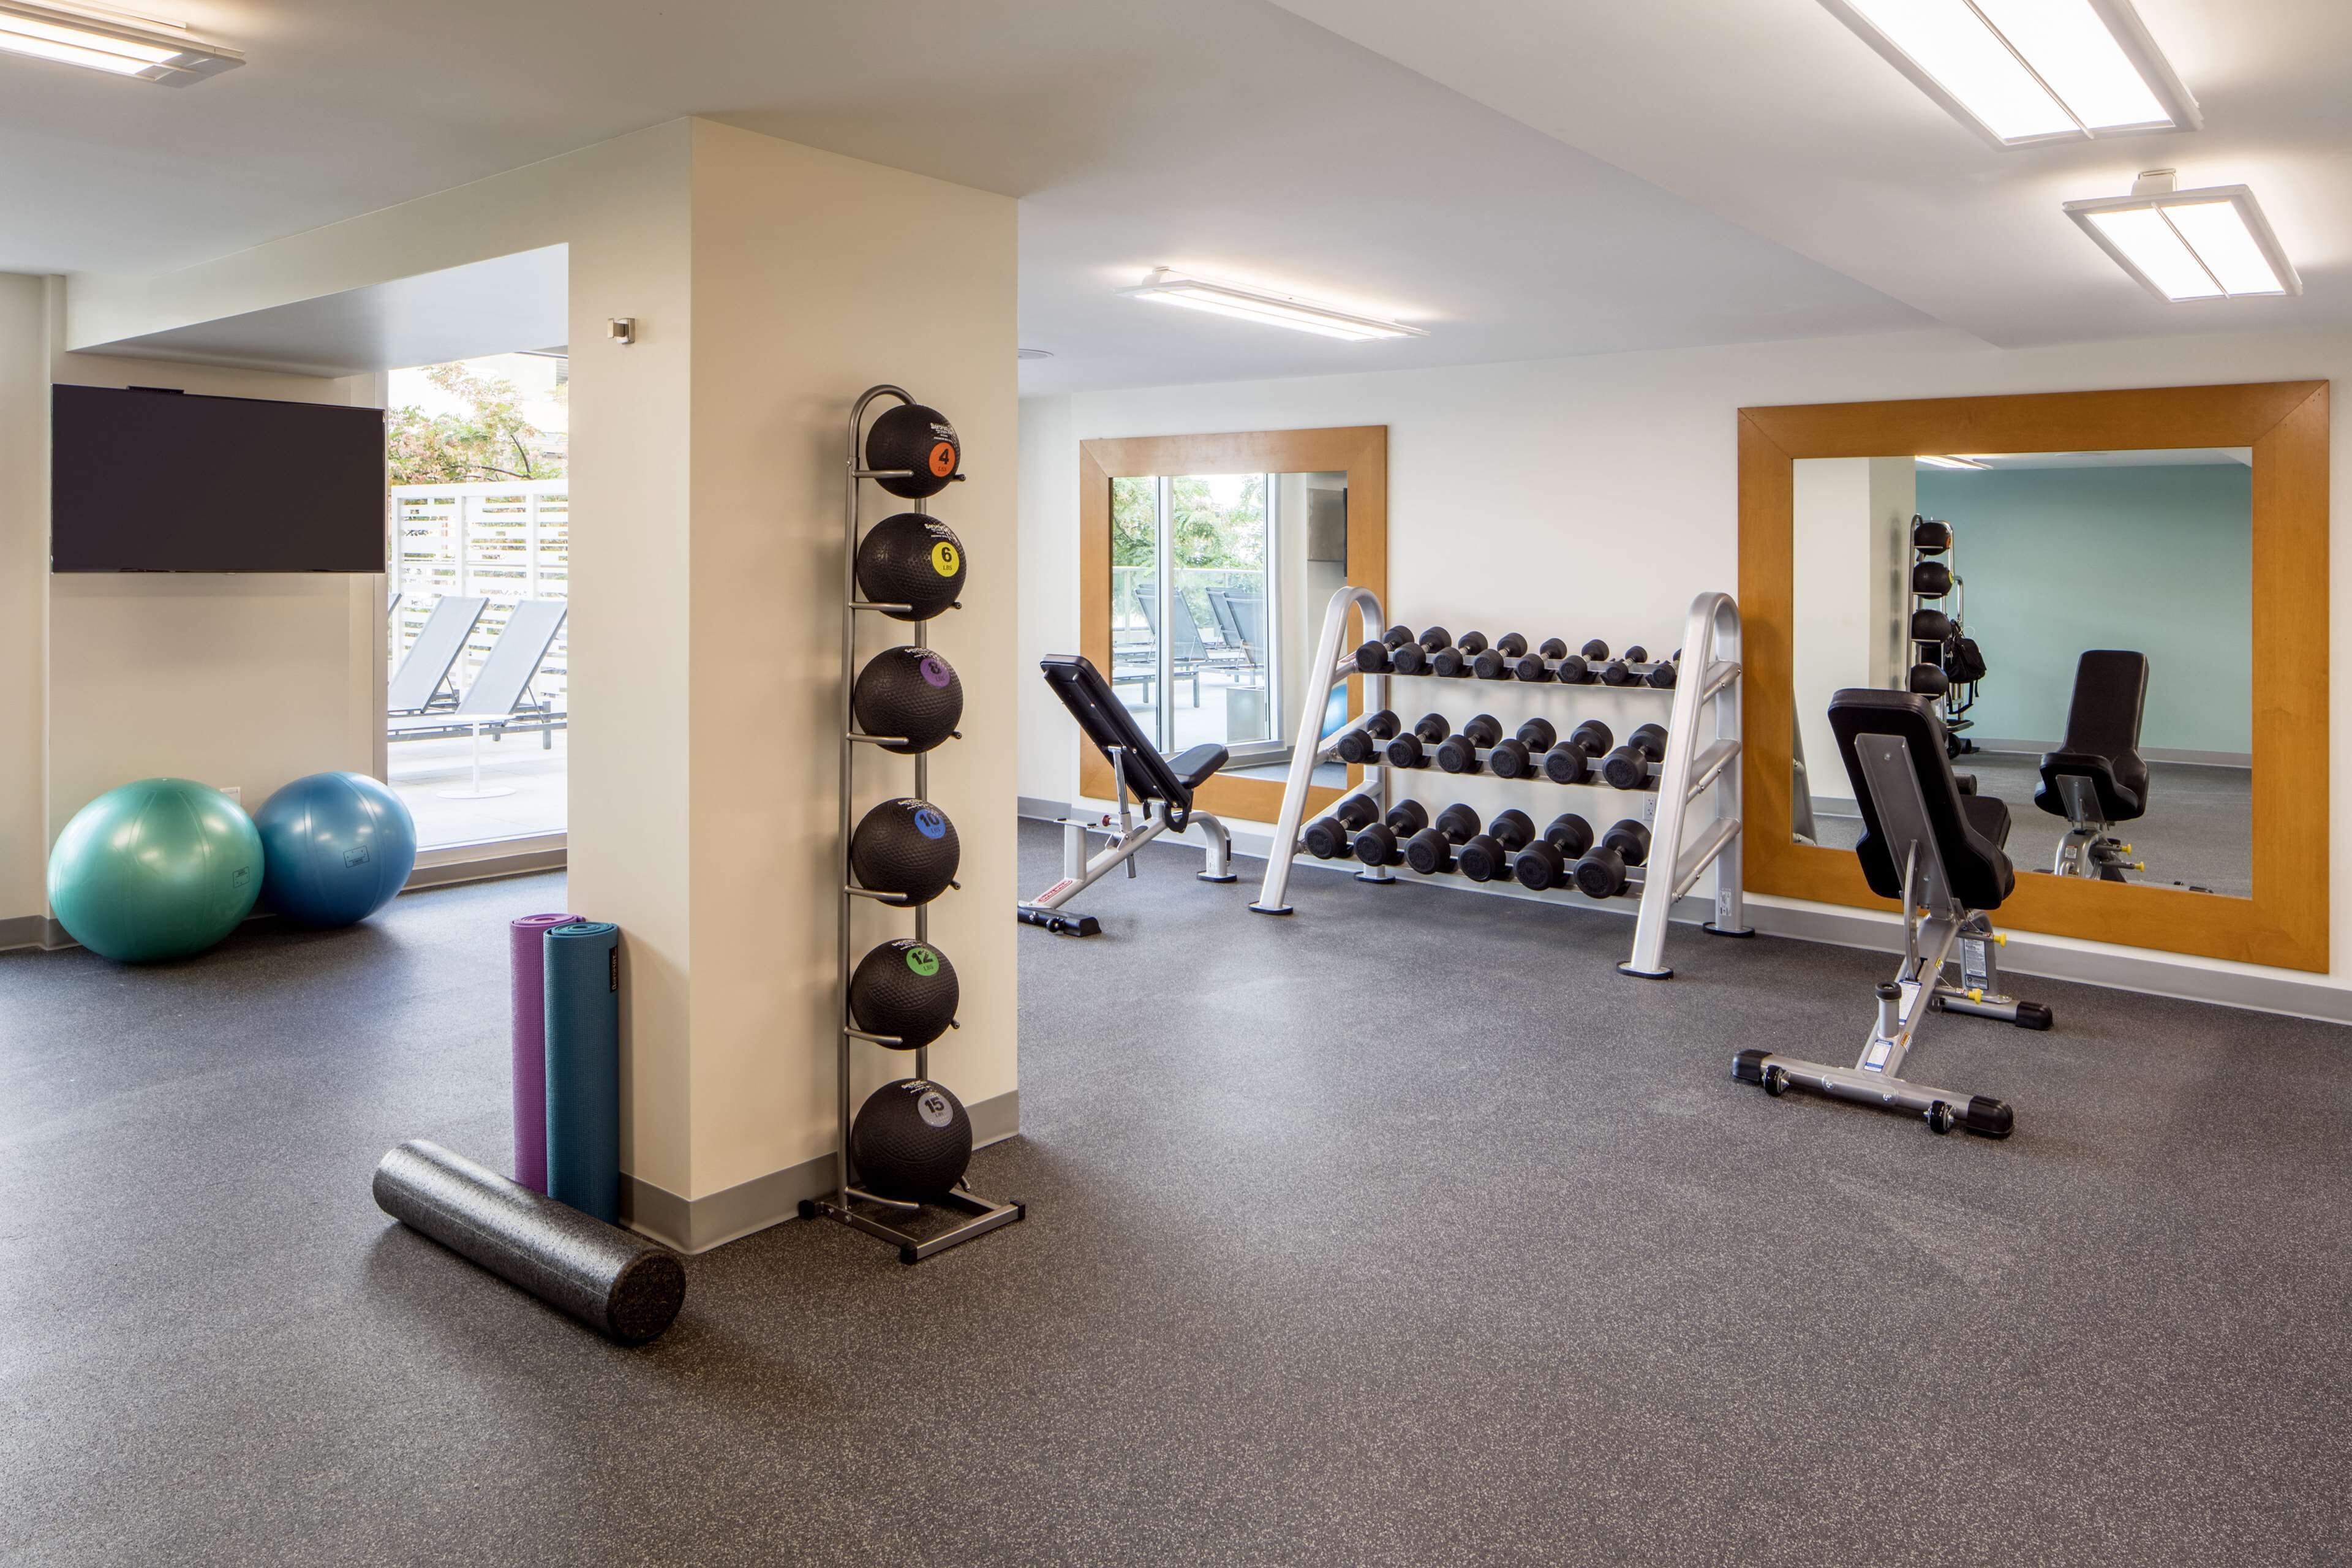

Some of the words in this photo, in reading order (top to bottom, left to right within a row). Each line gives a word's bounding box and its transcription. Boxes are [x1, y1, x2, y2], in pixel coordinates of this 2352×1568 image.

[938, 448, 949, 465] 4
[941, 546, 952, 563] 6
[928, 662, 942, 674] 8
[919, 812, 940, 827] 10
[911, 950, 933, 965] 12
[925, 1096, 944, 1114] 15
